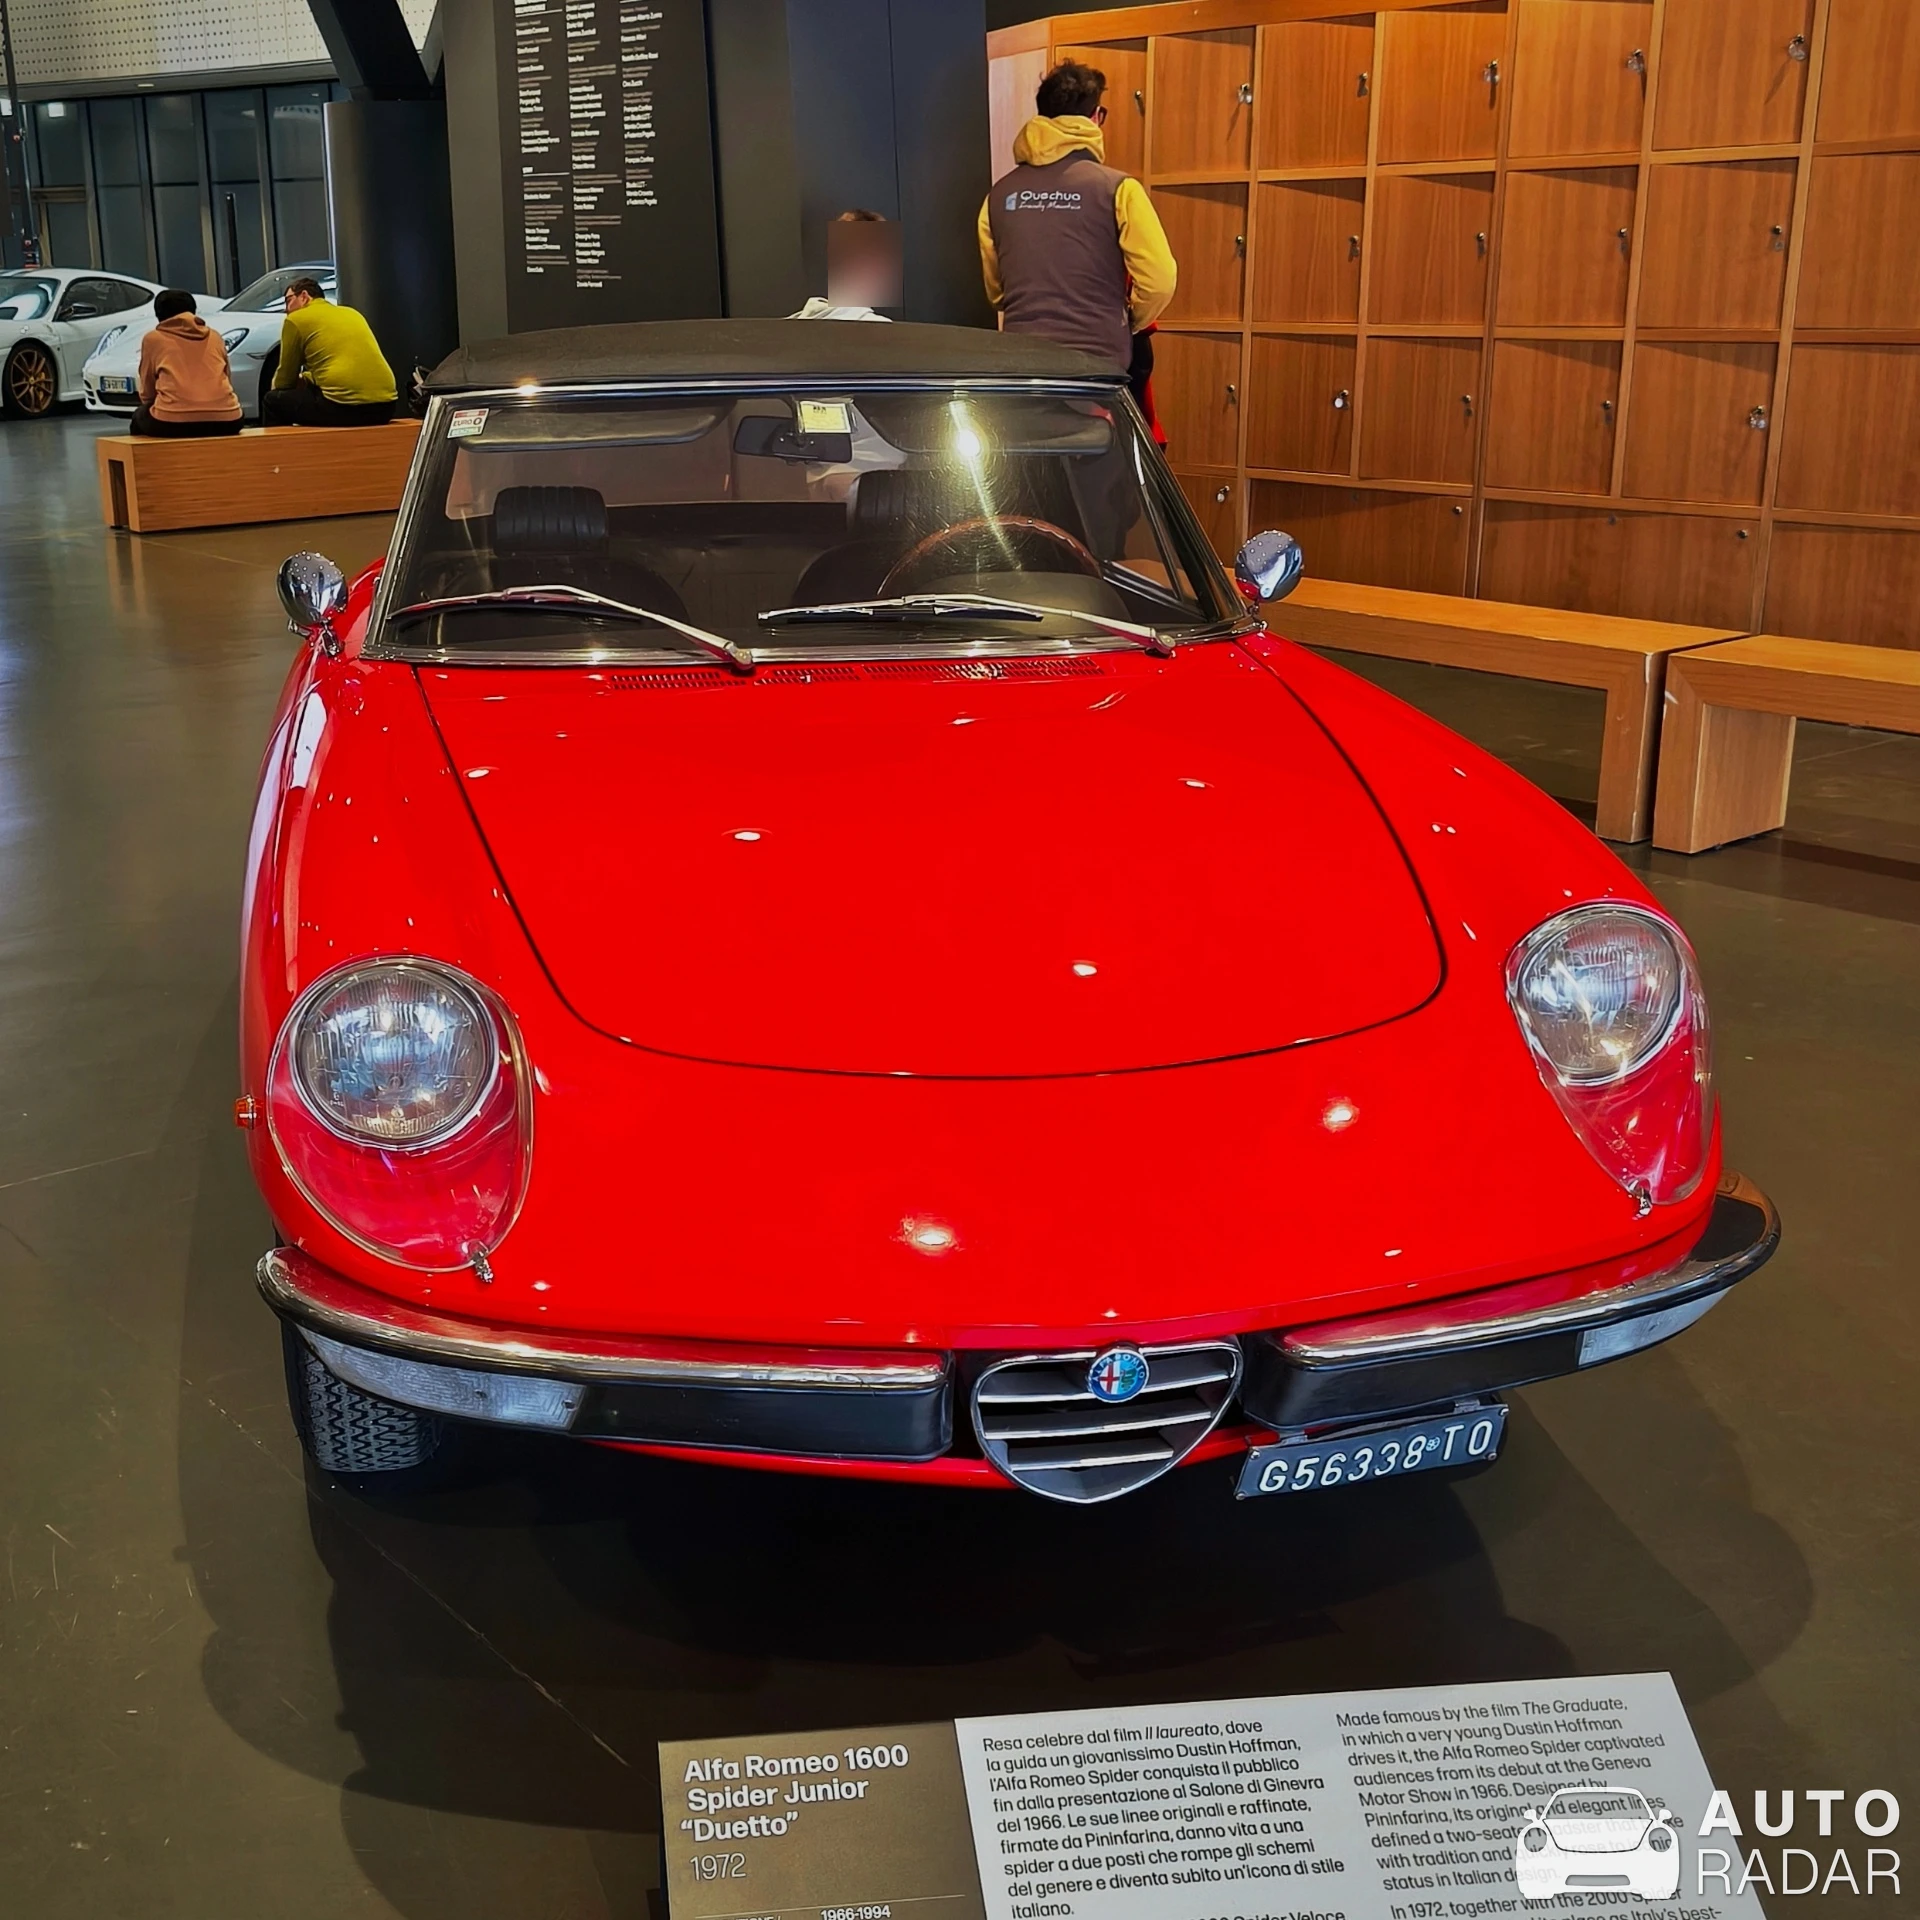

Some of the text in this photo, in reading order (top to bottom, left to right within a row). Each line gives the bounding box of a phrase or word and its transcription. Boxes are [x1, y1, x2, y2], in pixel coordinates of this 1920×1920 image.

[1020, 190, 1080, 200] Quechua
[1258, 1436, 1428, 1492] G56338
[1335, 1698, 1627, 1727] Made famous by the film The Graduate,
[982, 1720, 1262, 1751] Resa celebre dal film Il laureato, dove
[1341, 1717, 1622, 1746] in which a very young Dustin Hoffman
[684, 1744, 909, 1782] Alfa Romeo 1600
[985, 1737, 1301, 1773] la guida un giovanissimo Dustin Hoffman,
[1347, 1733, 1665, 1766] drives it, the Alfa Romeo Spider captivated
[989, 1757, 1299, 1792] l'Alfa Romeo Spider conquista il pubblico
[1353, 1757, 1651, 1786] audiences from its debut at the Geneva
[688, 1778, 869, 1814] Spider Junior
[993, 1777, 1324, 1812] fin dalla presentazione al Salone di Ginevra
[1358, 1776, 1609, 1806] Motor Show in 1966. Designed by
[996, 1798, 1311, 1833] del 1966. Le sue linee originali e raffinate,
[1364, 1809, 1452, 1827] Pininfarina,
[1453, 1807, 1474, 1822] its
[1474, 1802, 1534, 1825] original
[1534, 1801, 1565, 1816] and
[1566, 1796, 1628, 1818] elegant
[1000, 1820, 1304, 1854] firmate da Pininfarina, danno vita a una
[1370, 1830, 1431, 1847] defined
[1433, 1832, 1444, 1843] a
[1446, 1823, 1531, 1844] two-seater
[1535, 1820, 1604, 1838] radster
[690, 1853, 746, 1881] 1972
[1003, 1838, 1315, 1878] spider a due posti che rompe gli schemi
[1375, 1853, 1411, 1869] with
[1412, 1849, 1479, 1866] tradition
[1481, 1846, 1512, 1862] and
[1007, 1857, 1344, 1898] del genere e diventa subito un'icona di stile
[1382, 1875, 1434, 1890] status
[1435, 1873, 1451, 1886] in
[1452, 1869, 1502, 1885] Italian
[820, 1905, 891, 1920] 1966-1994
[1011, 1902, 1074, 1918] italiano.
[1390, 1904, 1405, 1918] In
[1407, 1900, 1448, 1920] 1972,
[1448, 1897, 1517, 1915] together
[1520, 1893, 1555, 1910] with
[1555, 1891, 1583, 1908] the
[1584, 1889, 1629, 1906] 2000
